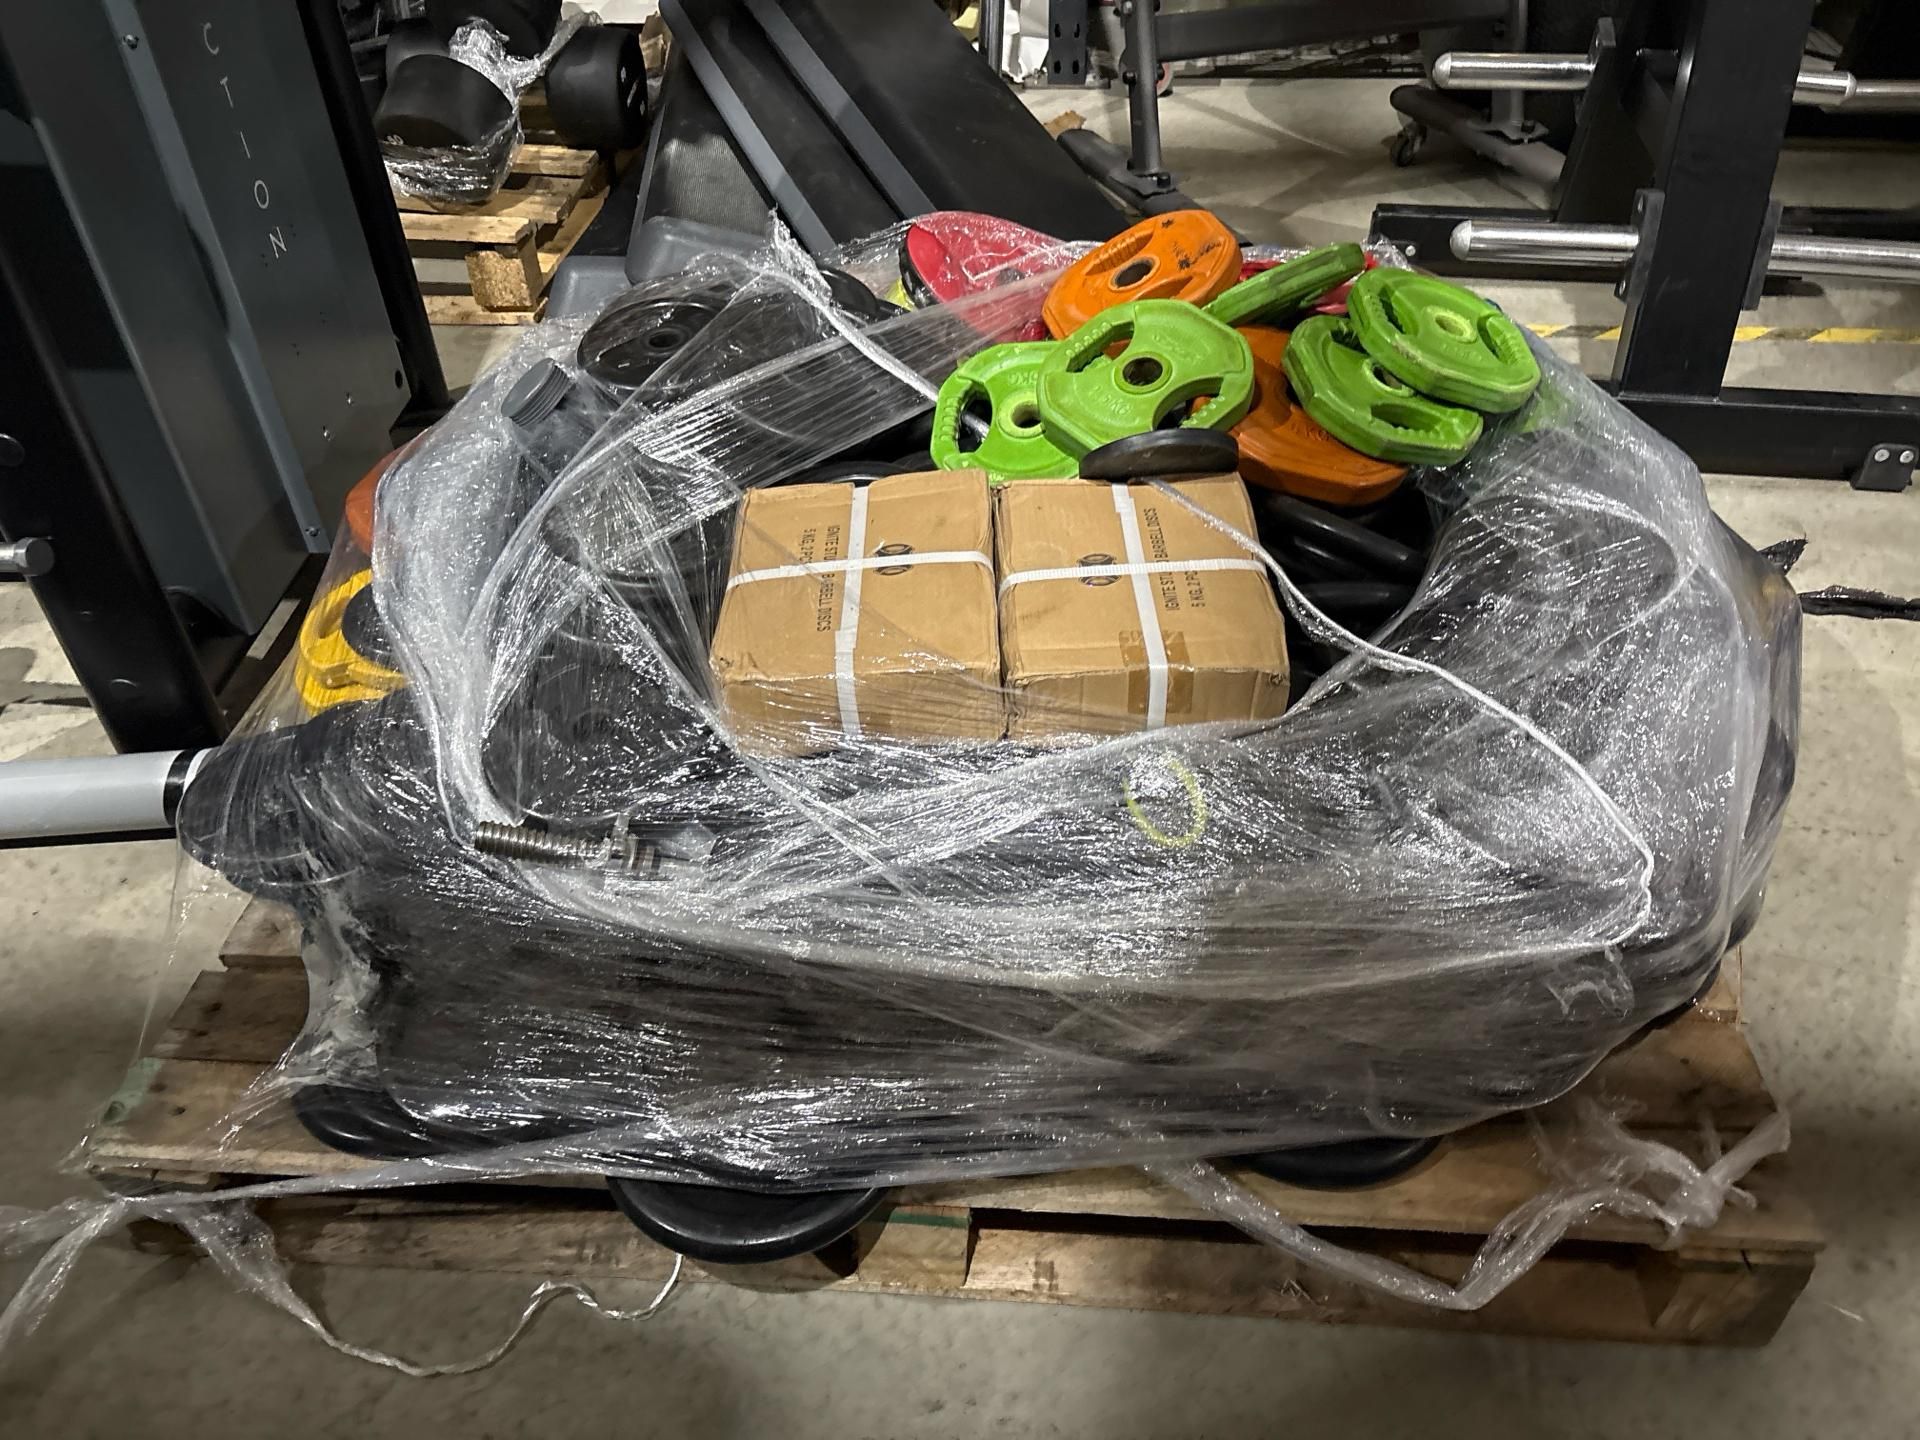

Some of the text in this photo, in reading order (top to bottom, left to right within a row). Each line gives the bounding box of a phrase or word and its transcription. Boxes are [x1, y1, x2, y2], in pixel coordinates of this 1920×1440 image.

[1143, 507, 1161, 527] DISCS
[825, 525, 840, 546] IGNITE
[1149, 527, 1168, 558] BARBELL
[1160, 586, 1180, 611] IGNITE
[816, 607, 832, 632] DISCS
